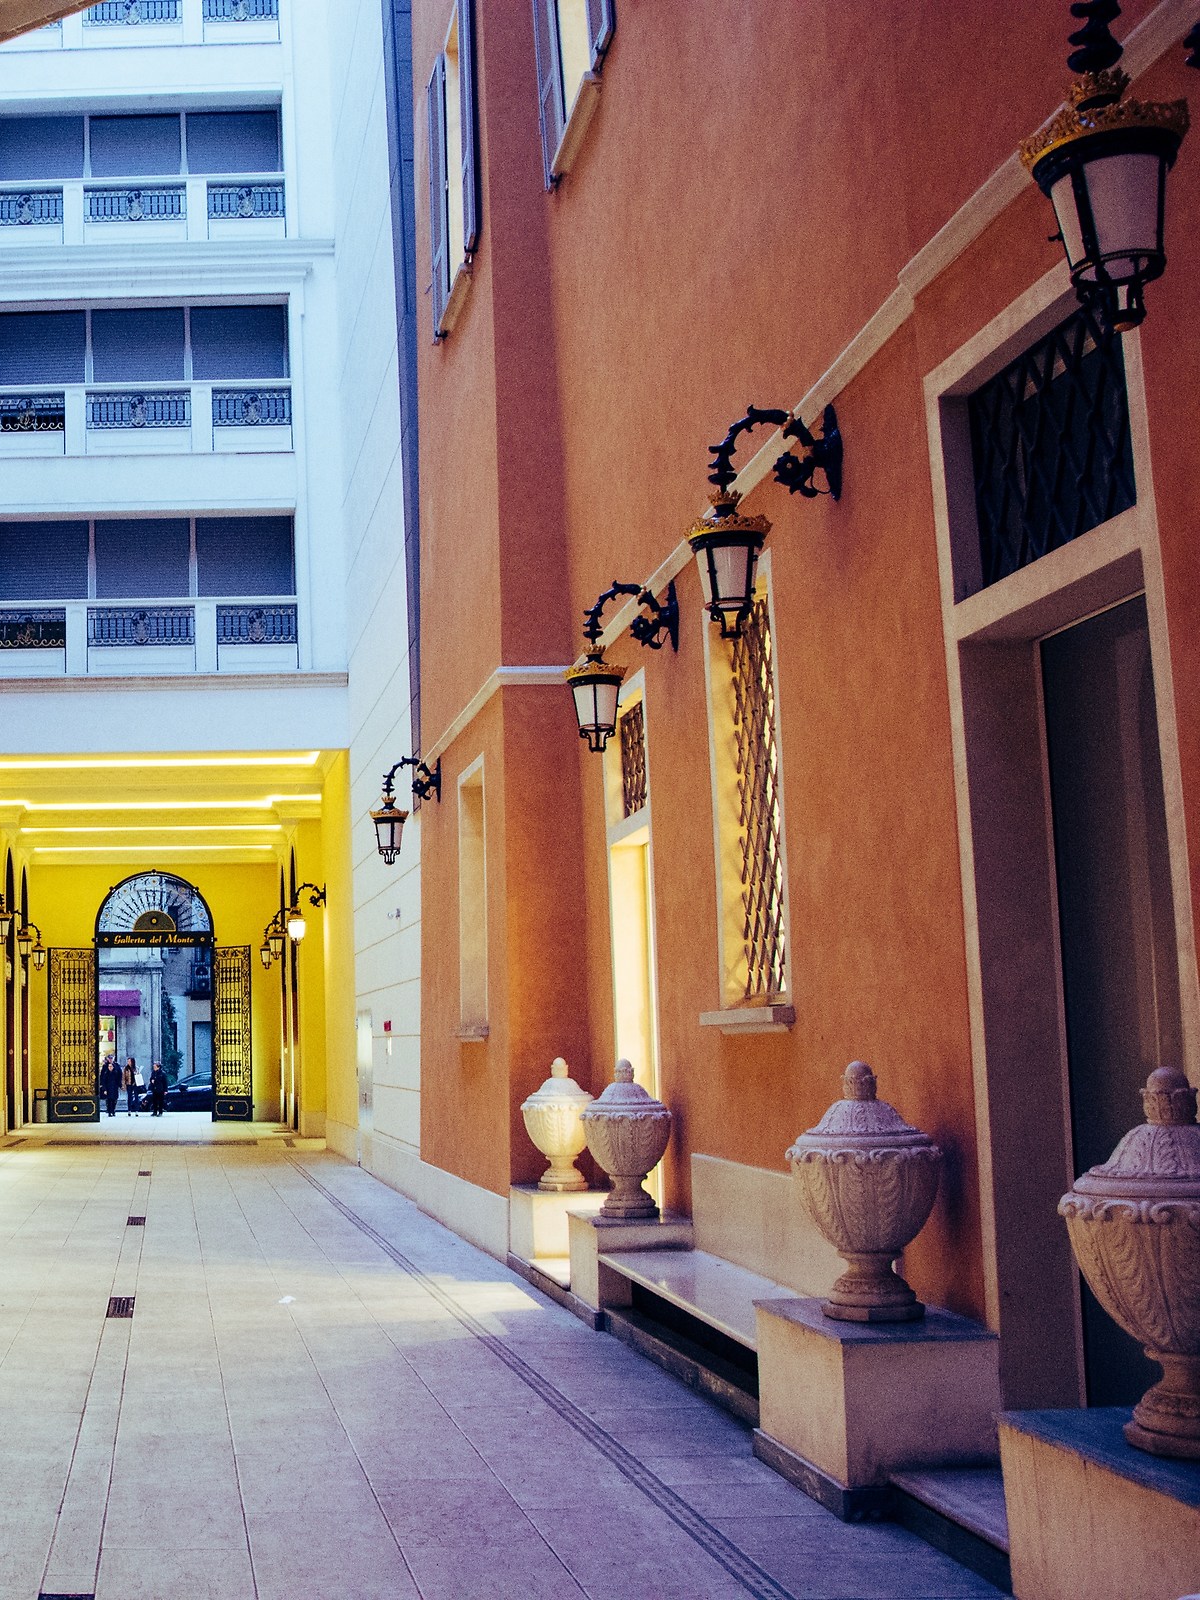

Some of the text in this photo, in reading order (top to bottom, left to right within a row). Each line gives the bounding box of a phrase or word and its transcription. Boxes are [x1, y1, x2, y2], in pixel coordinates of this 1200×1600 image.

[114, 934, 194, 945] Galleria del Monte
